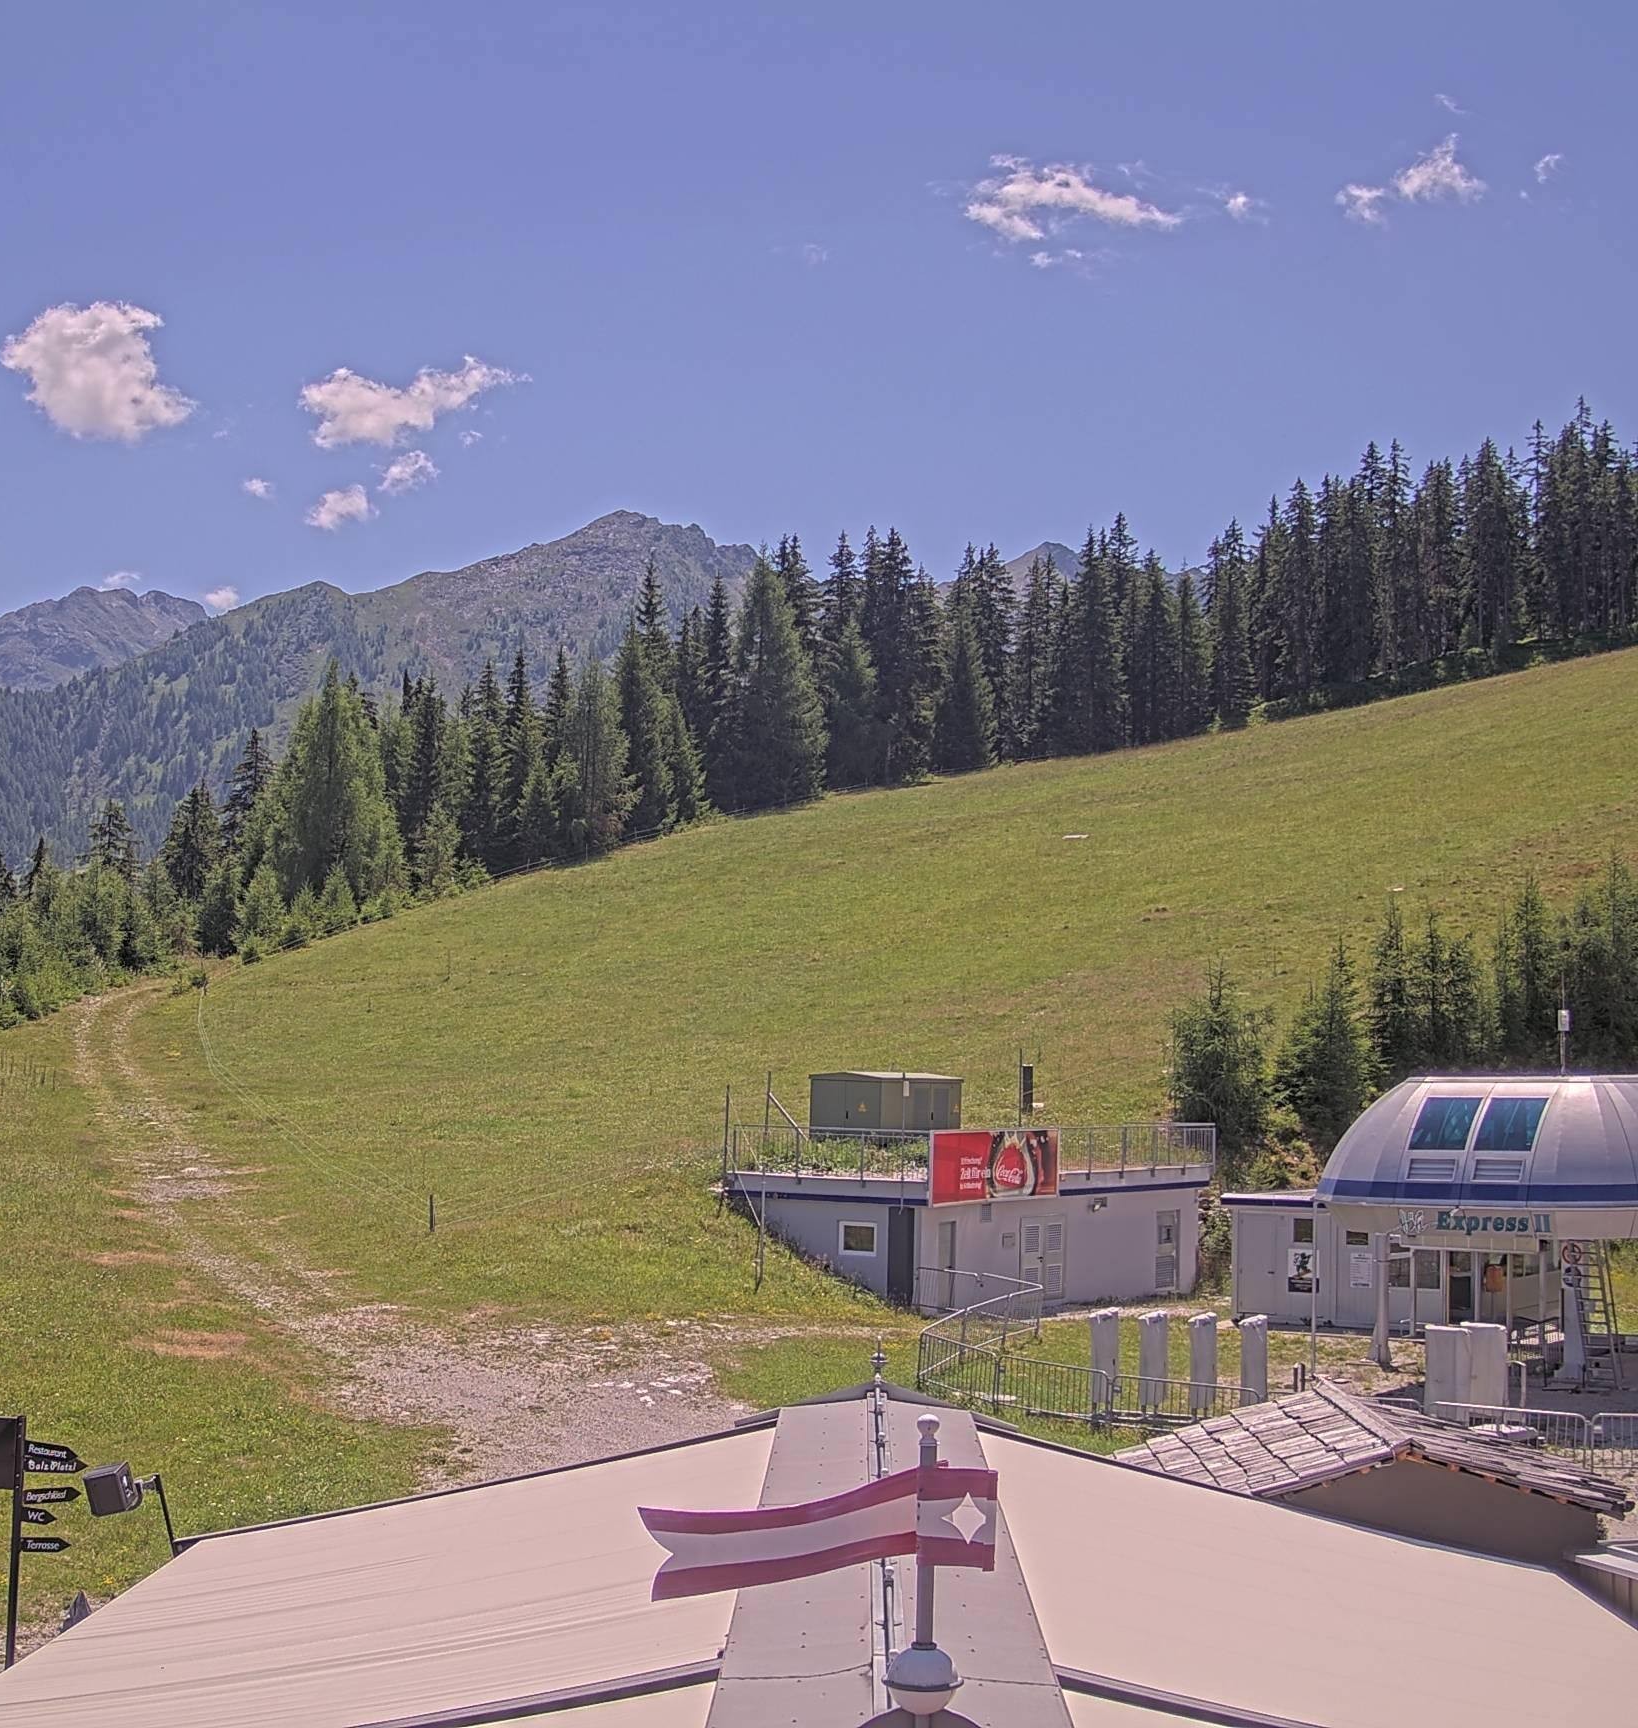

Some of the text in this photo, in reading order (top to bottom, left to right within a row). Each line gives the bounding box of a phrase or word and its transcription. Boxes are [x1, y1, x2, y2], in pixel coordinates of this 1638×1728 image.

[1436, 1211, 1529, 1236] Express
[28, 1510, 46, 1522] WC
[26, 1540, 60, 1550] Terrasse
